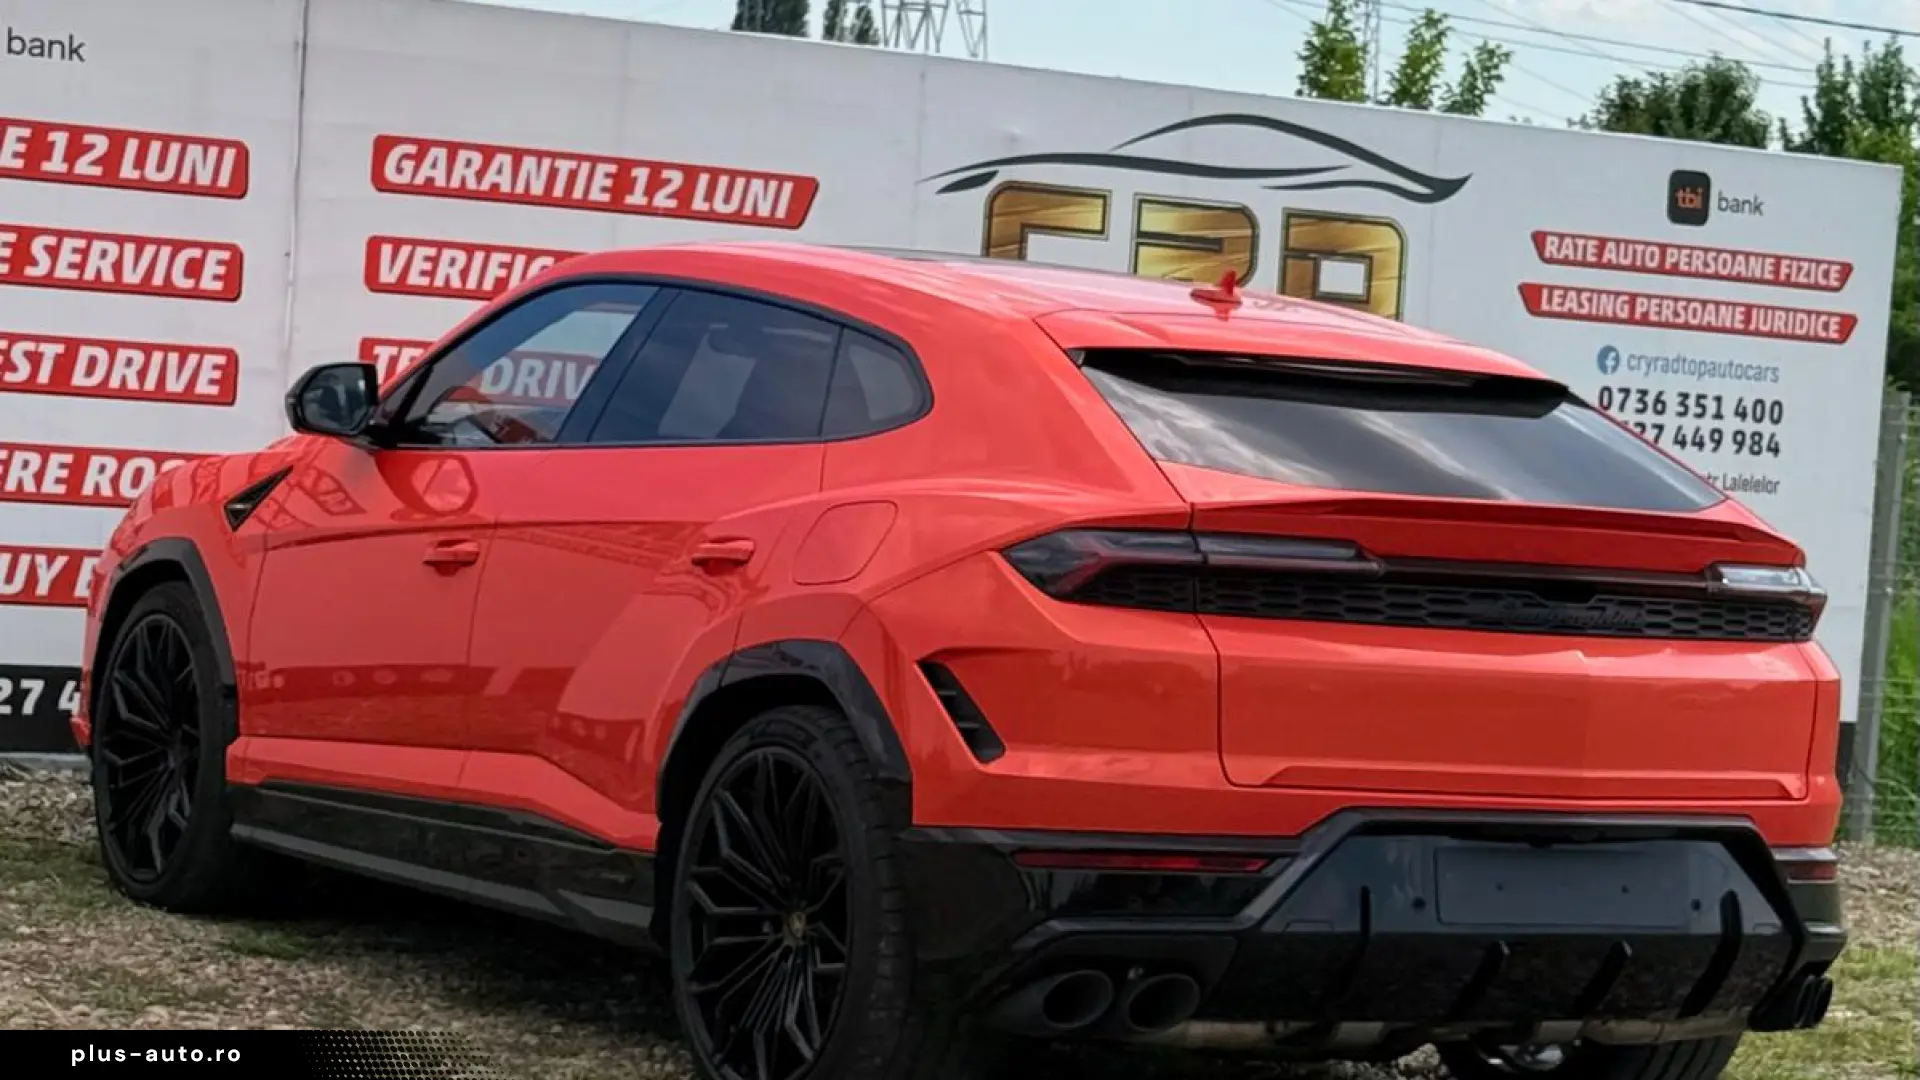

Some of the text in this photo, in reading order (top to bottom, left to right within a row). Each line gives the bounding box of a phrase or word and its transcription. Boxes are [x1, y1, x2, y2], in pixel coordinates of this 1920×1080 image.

[7, 27, 86, 63] bank
[40, 131, 110, 177] 12
[119, 137, 237, 188] LUNI
[383, 143, 794, 219] GARANTIE 12 LUNI
[1675, 187, 1765, 216] tbi bank
[23, 235, 232, 291] SERVICE
[1544, 234, 1842, 287] RATE AUTO PERSOANE FIZICE
[1540, 287, 1842, 338] LEASING PERSOANE JURIDICE
[0, 339, 227, 394] ST DRIVE
[1626, 352, 1780, 384] cryradtopautocars
[1598, 386, 1785, 426] 0736 351 400
[1673, 424, 1725, 454] 449
[1732, 431, 1782, 458] 984
[0, 451, 75, 495] RE
